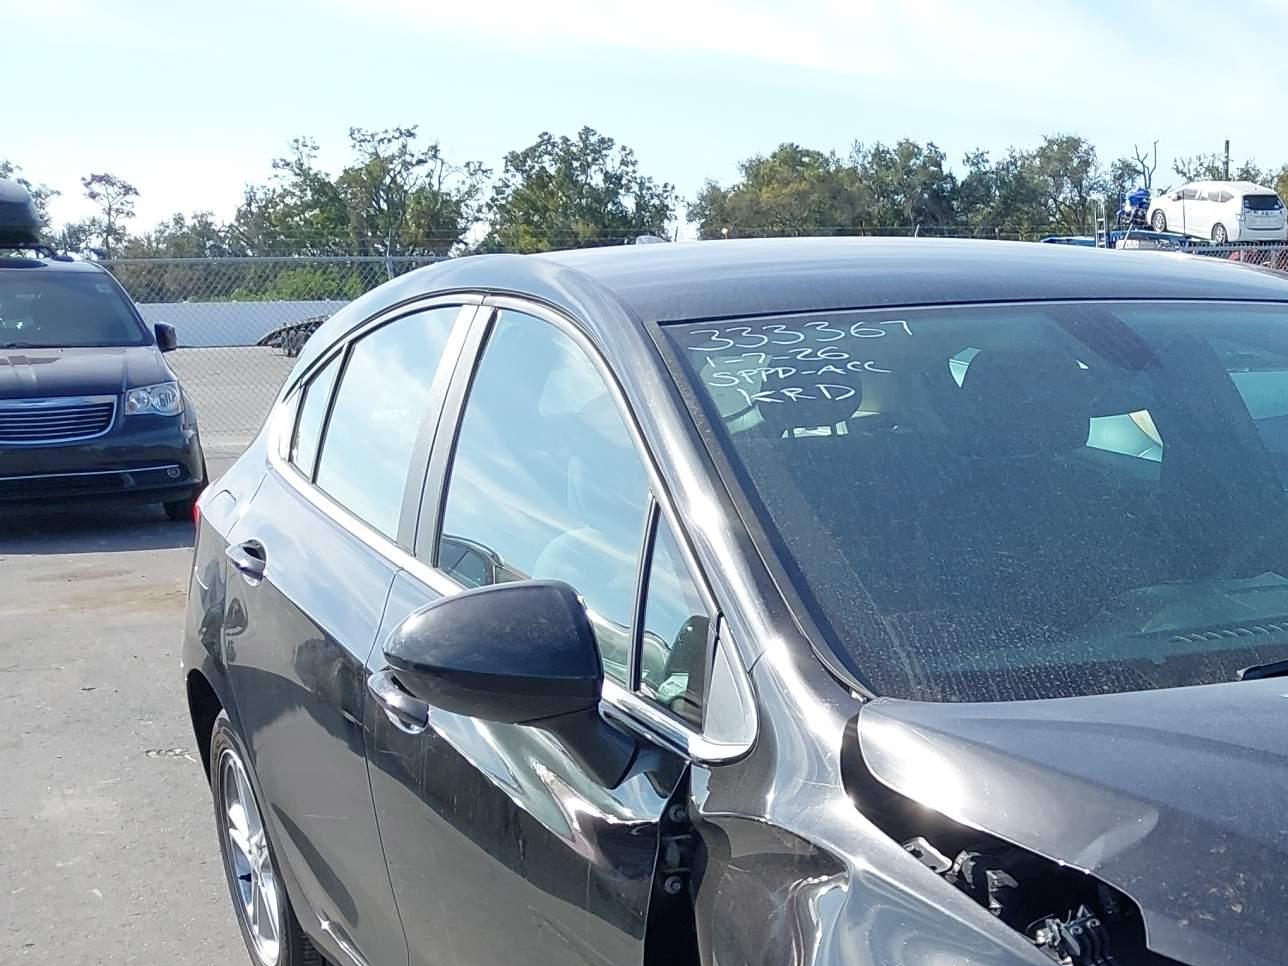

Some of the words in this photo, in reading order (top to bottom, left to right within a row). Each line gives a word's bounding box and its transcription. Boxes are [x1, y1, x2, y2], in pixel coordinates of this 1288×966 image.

[688, 321, 913, 351] 333367
[706, 346, 849, 368] 1-7-26
[736, 384, 855, 407] KRD
